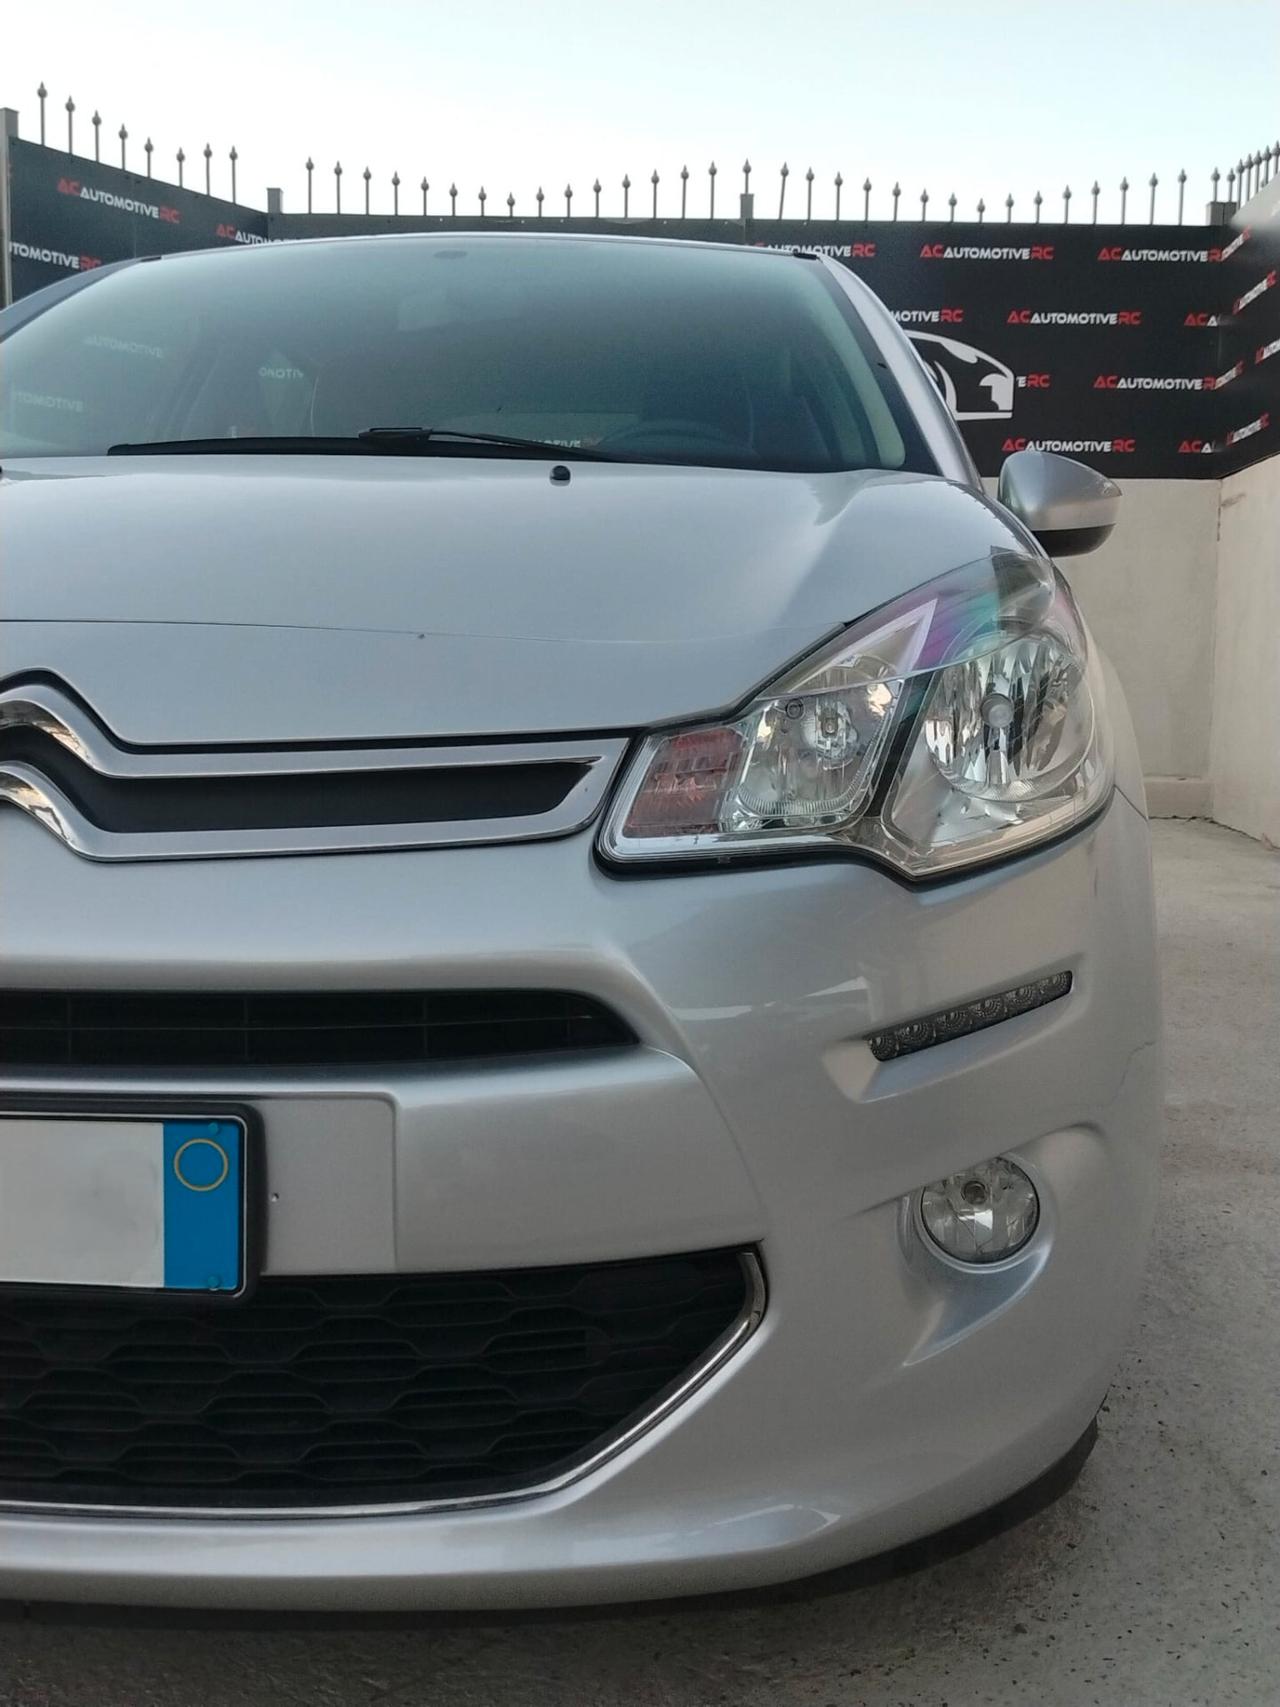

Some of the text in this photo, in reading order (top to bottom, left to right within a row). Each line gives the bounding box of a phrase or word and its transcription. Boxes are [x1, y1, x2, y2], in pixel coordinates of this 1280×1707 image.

[57, 177, 180, 224] ACAUTOMOTIVERC
[215, 223, 283, 246] ACAUTO
[920, 244, 1054, 260] ACAUTOMOTIVERC
[1007, 310, 1141, 326] ACAUTOMOTIVERC
[1184, 313, 1220, 327] ACA
[1016, 374, 1051, 388] ERC
[1002, 438, 1136, 454] ACAUTOMOTIVERC
[1179, 440, 1214, 454] ACA
